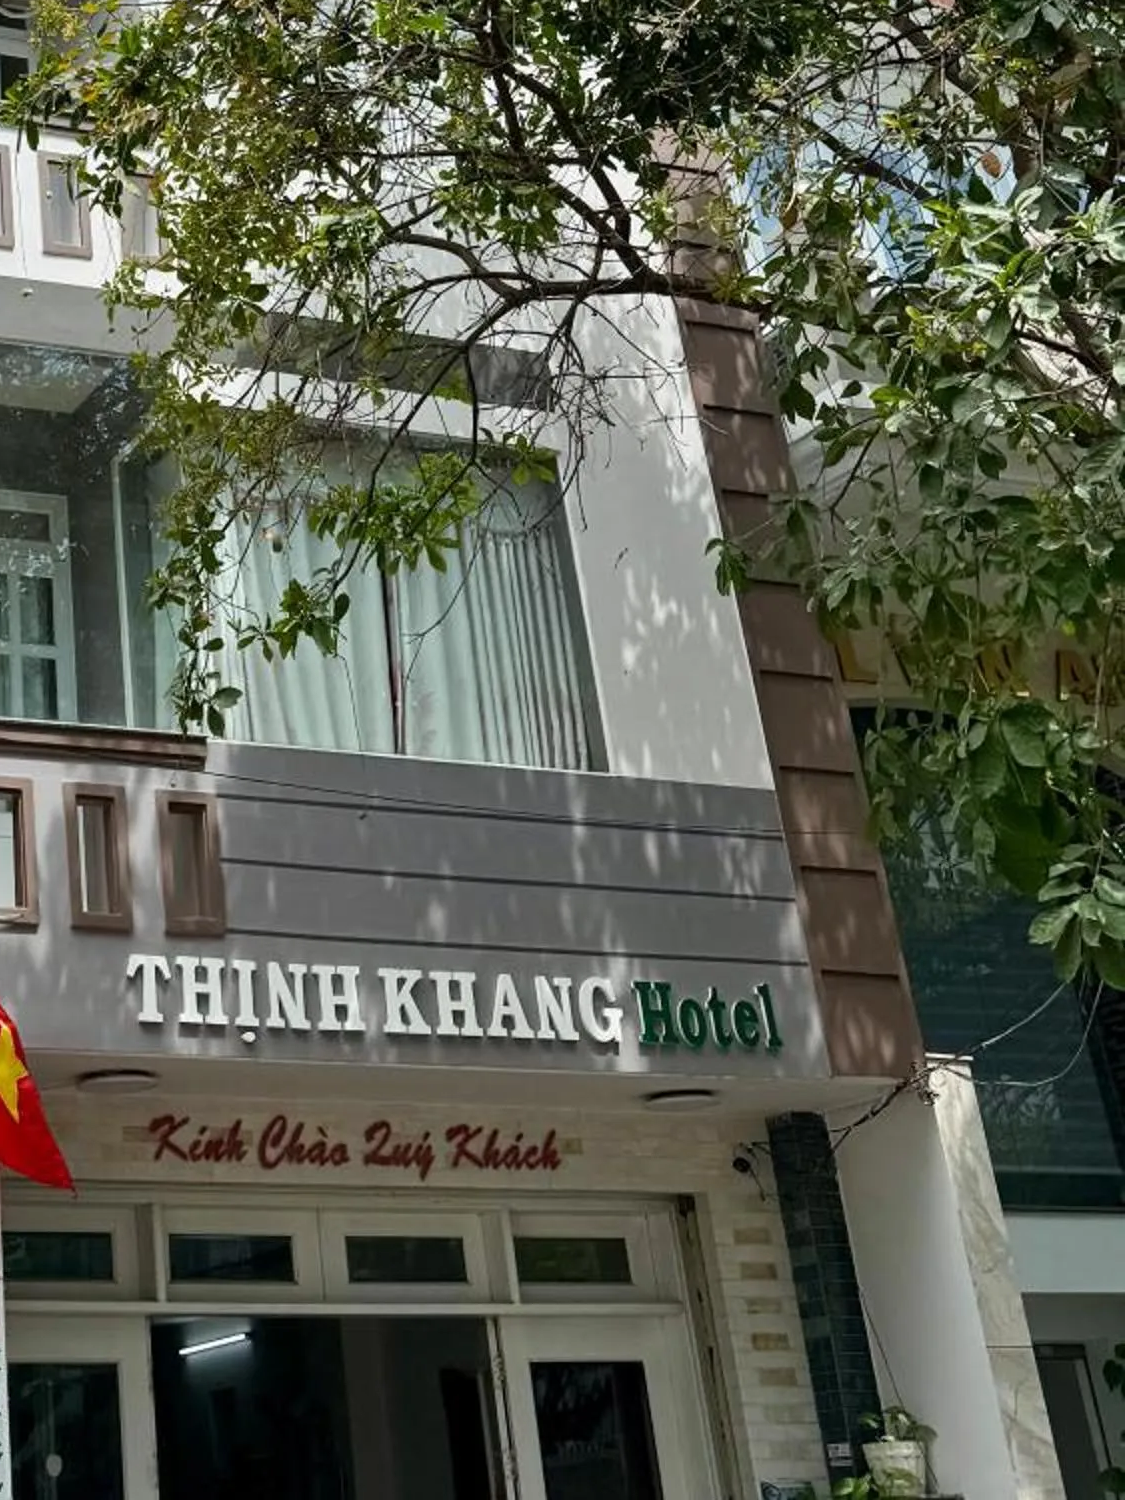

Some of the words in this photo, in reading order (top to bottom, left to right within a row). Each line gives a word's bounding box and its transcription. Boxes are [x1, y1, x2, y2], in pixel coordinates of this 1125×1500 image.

[126, 954, 366, 1044] THỊNH
[377, 967, 623, 1045] KHANG
[630, 980, 783, 1050] Hotel
[148, 1113, 248, 1163] Kính
[258, 1114, 351, 1170] Chào
[363, 1119, 436, 1182] Quý
[445, 1123, 562, 1171] Khách
